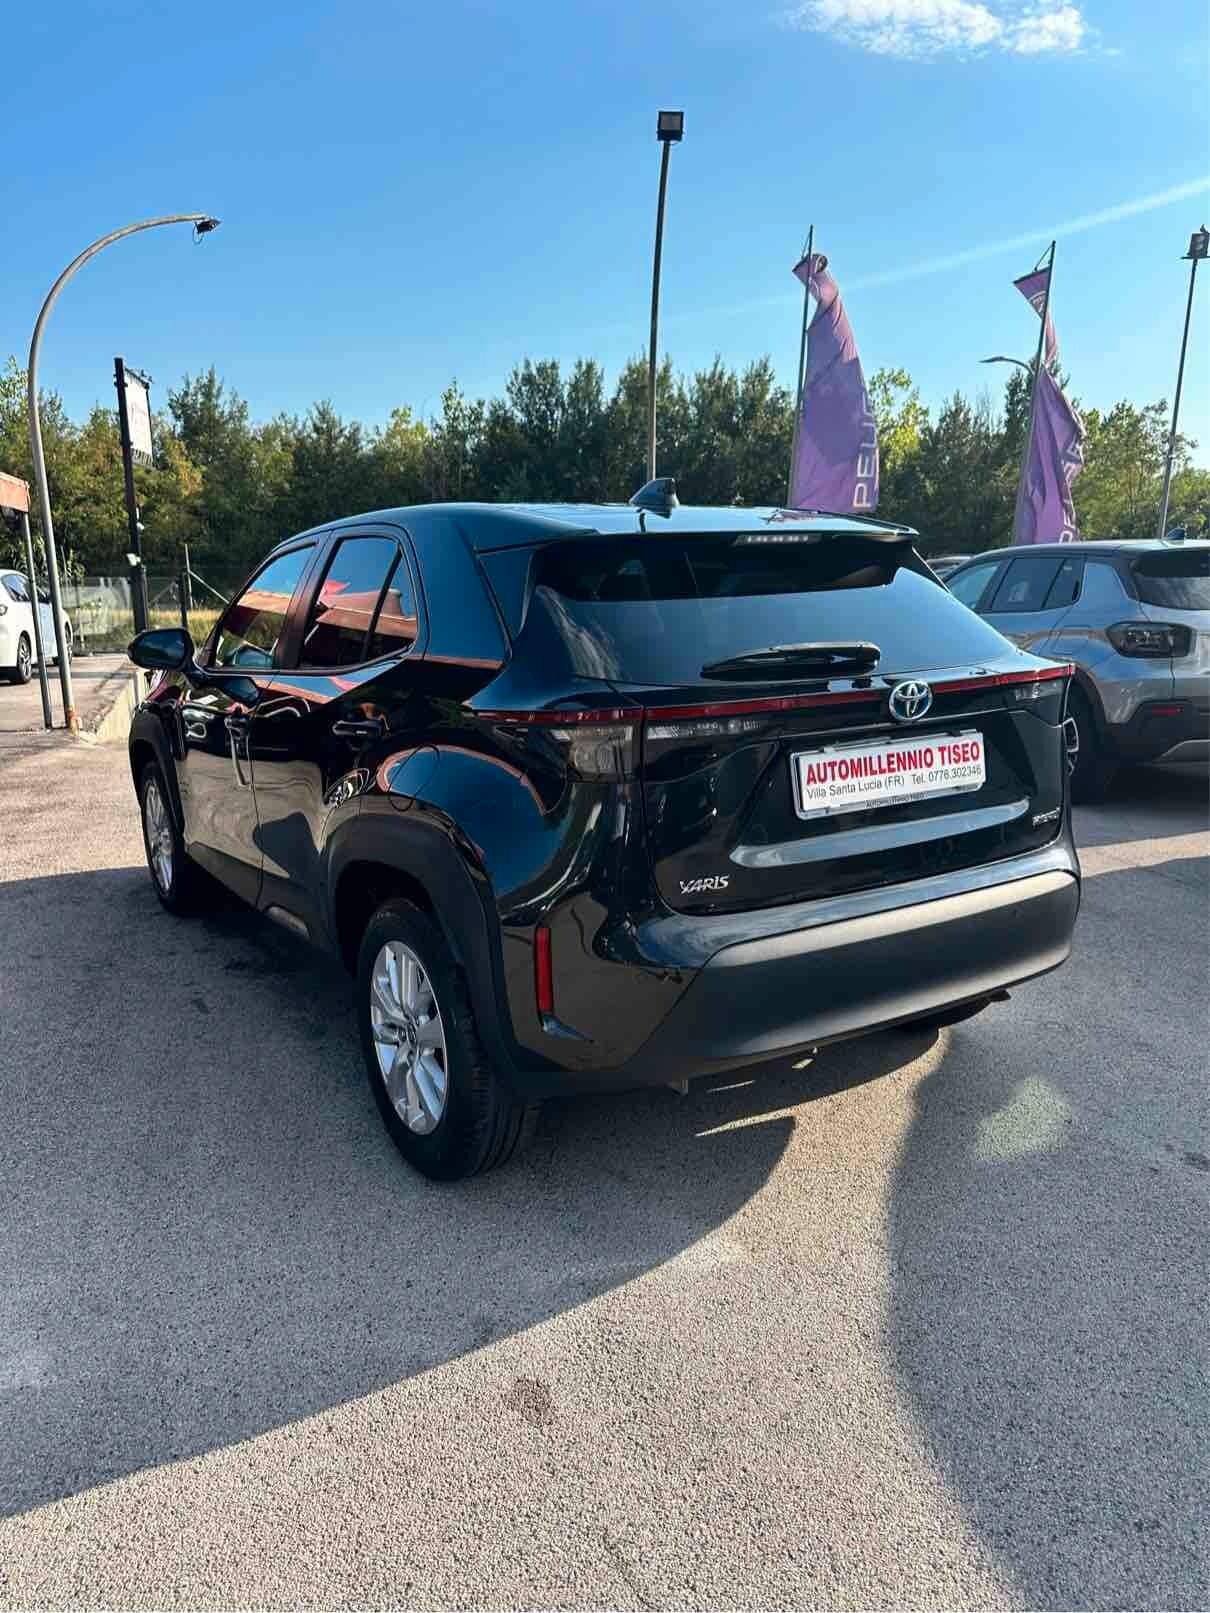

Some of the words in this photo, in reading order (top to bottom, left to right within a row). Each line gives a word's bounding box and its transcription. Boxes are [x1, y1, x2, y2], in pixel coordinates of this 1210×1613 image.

[806, 748, 934, 785] AUTOMILLENNIO
[938, 742, 981, 766] TISEO
[807, 786, 827, 800] Villa
[829, 783, 856, 797] Santa
[858, 779, 882, 792] Lucia
[884, 775, 905, 791] (FR)
[912, 774, 926, 785] Tel.
[680, 874, 729, 894] YARIS
